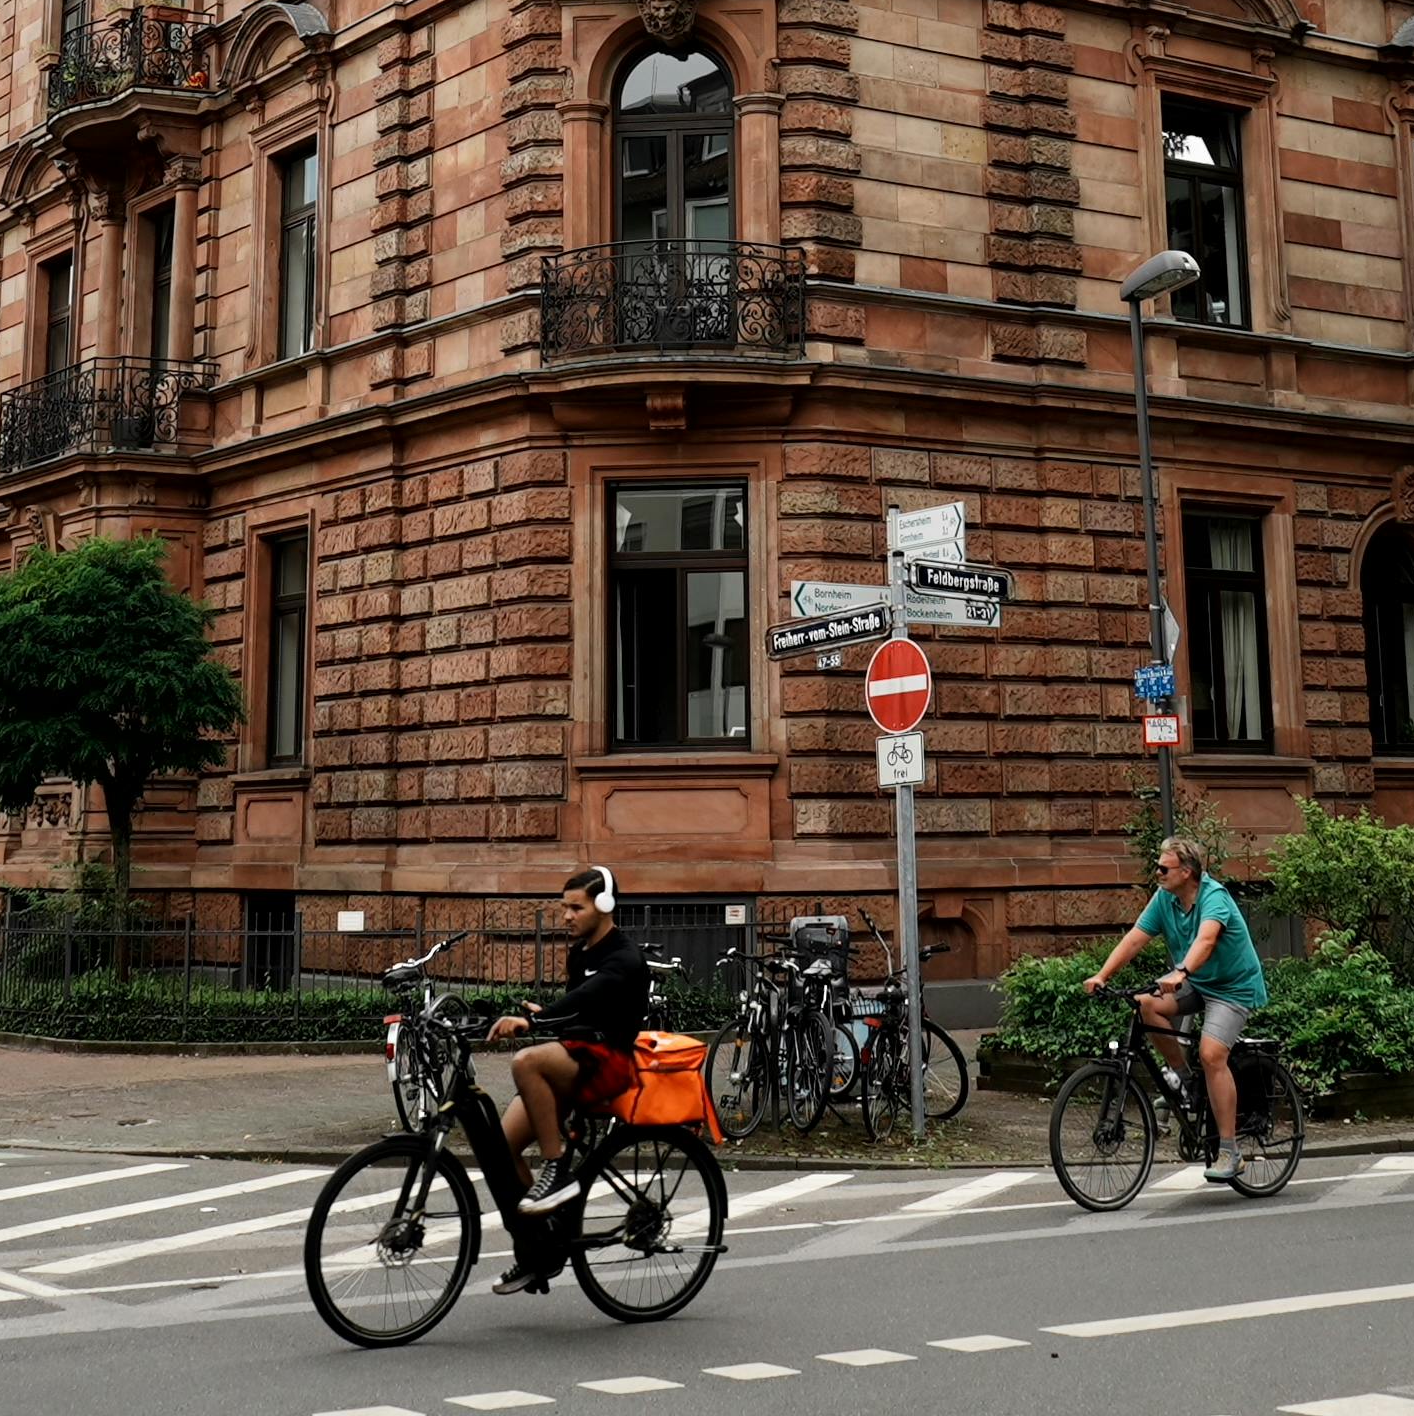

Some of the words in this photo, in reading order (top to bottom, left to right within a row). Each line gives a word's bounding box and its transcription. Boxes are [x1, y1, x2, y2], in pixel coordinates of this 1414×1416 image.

[927, 568, 1000, 594] Feldbergstraße
[814, 587, 852, 600] Bornheim
[906, 608, 953, 620] Bockenheim
[966, 606, 991, 619] 21-31
[772, 612, 881, 651] Freiherr-vom-Stein-Straße
[893, 768, 908, 779] frei
